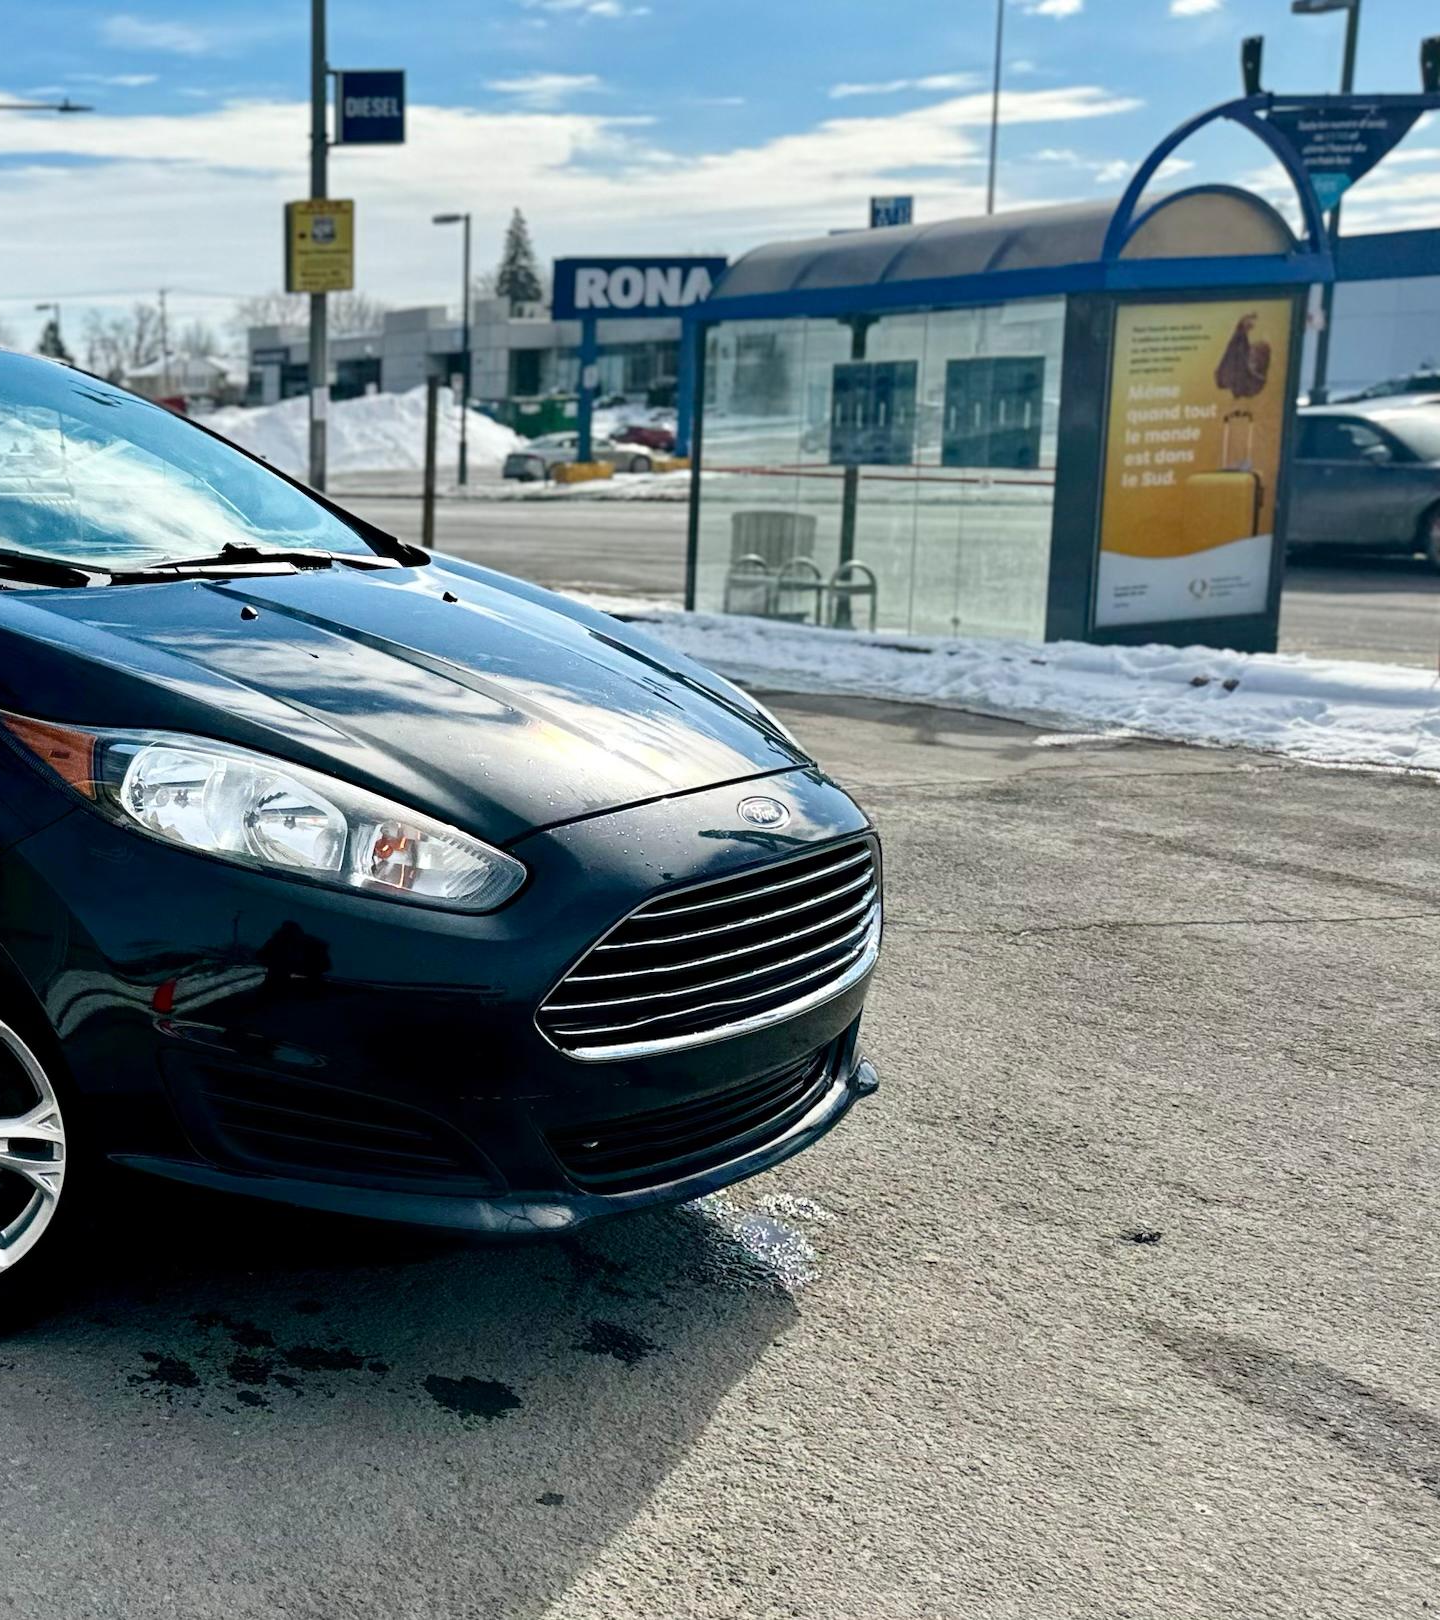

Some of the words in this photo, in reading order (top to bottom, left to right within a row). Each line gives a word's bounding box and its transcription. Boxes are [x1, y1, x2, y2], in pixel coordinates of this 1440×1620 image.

[345, 96, 401, 118] DIESEL
[574, 266, 713, 309] RONA
[1126, 404, 1182, 425] quand
[1183, 403, 1218, 420] tout
[1124, 428, 1141, 445] le
[1143, 426, 1201, 443] monde
[1123, 449, 1150, 467] est
[1153, 447, 1195, 464] dans
